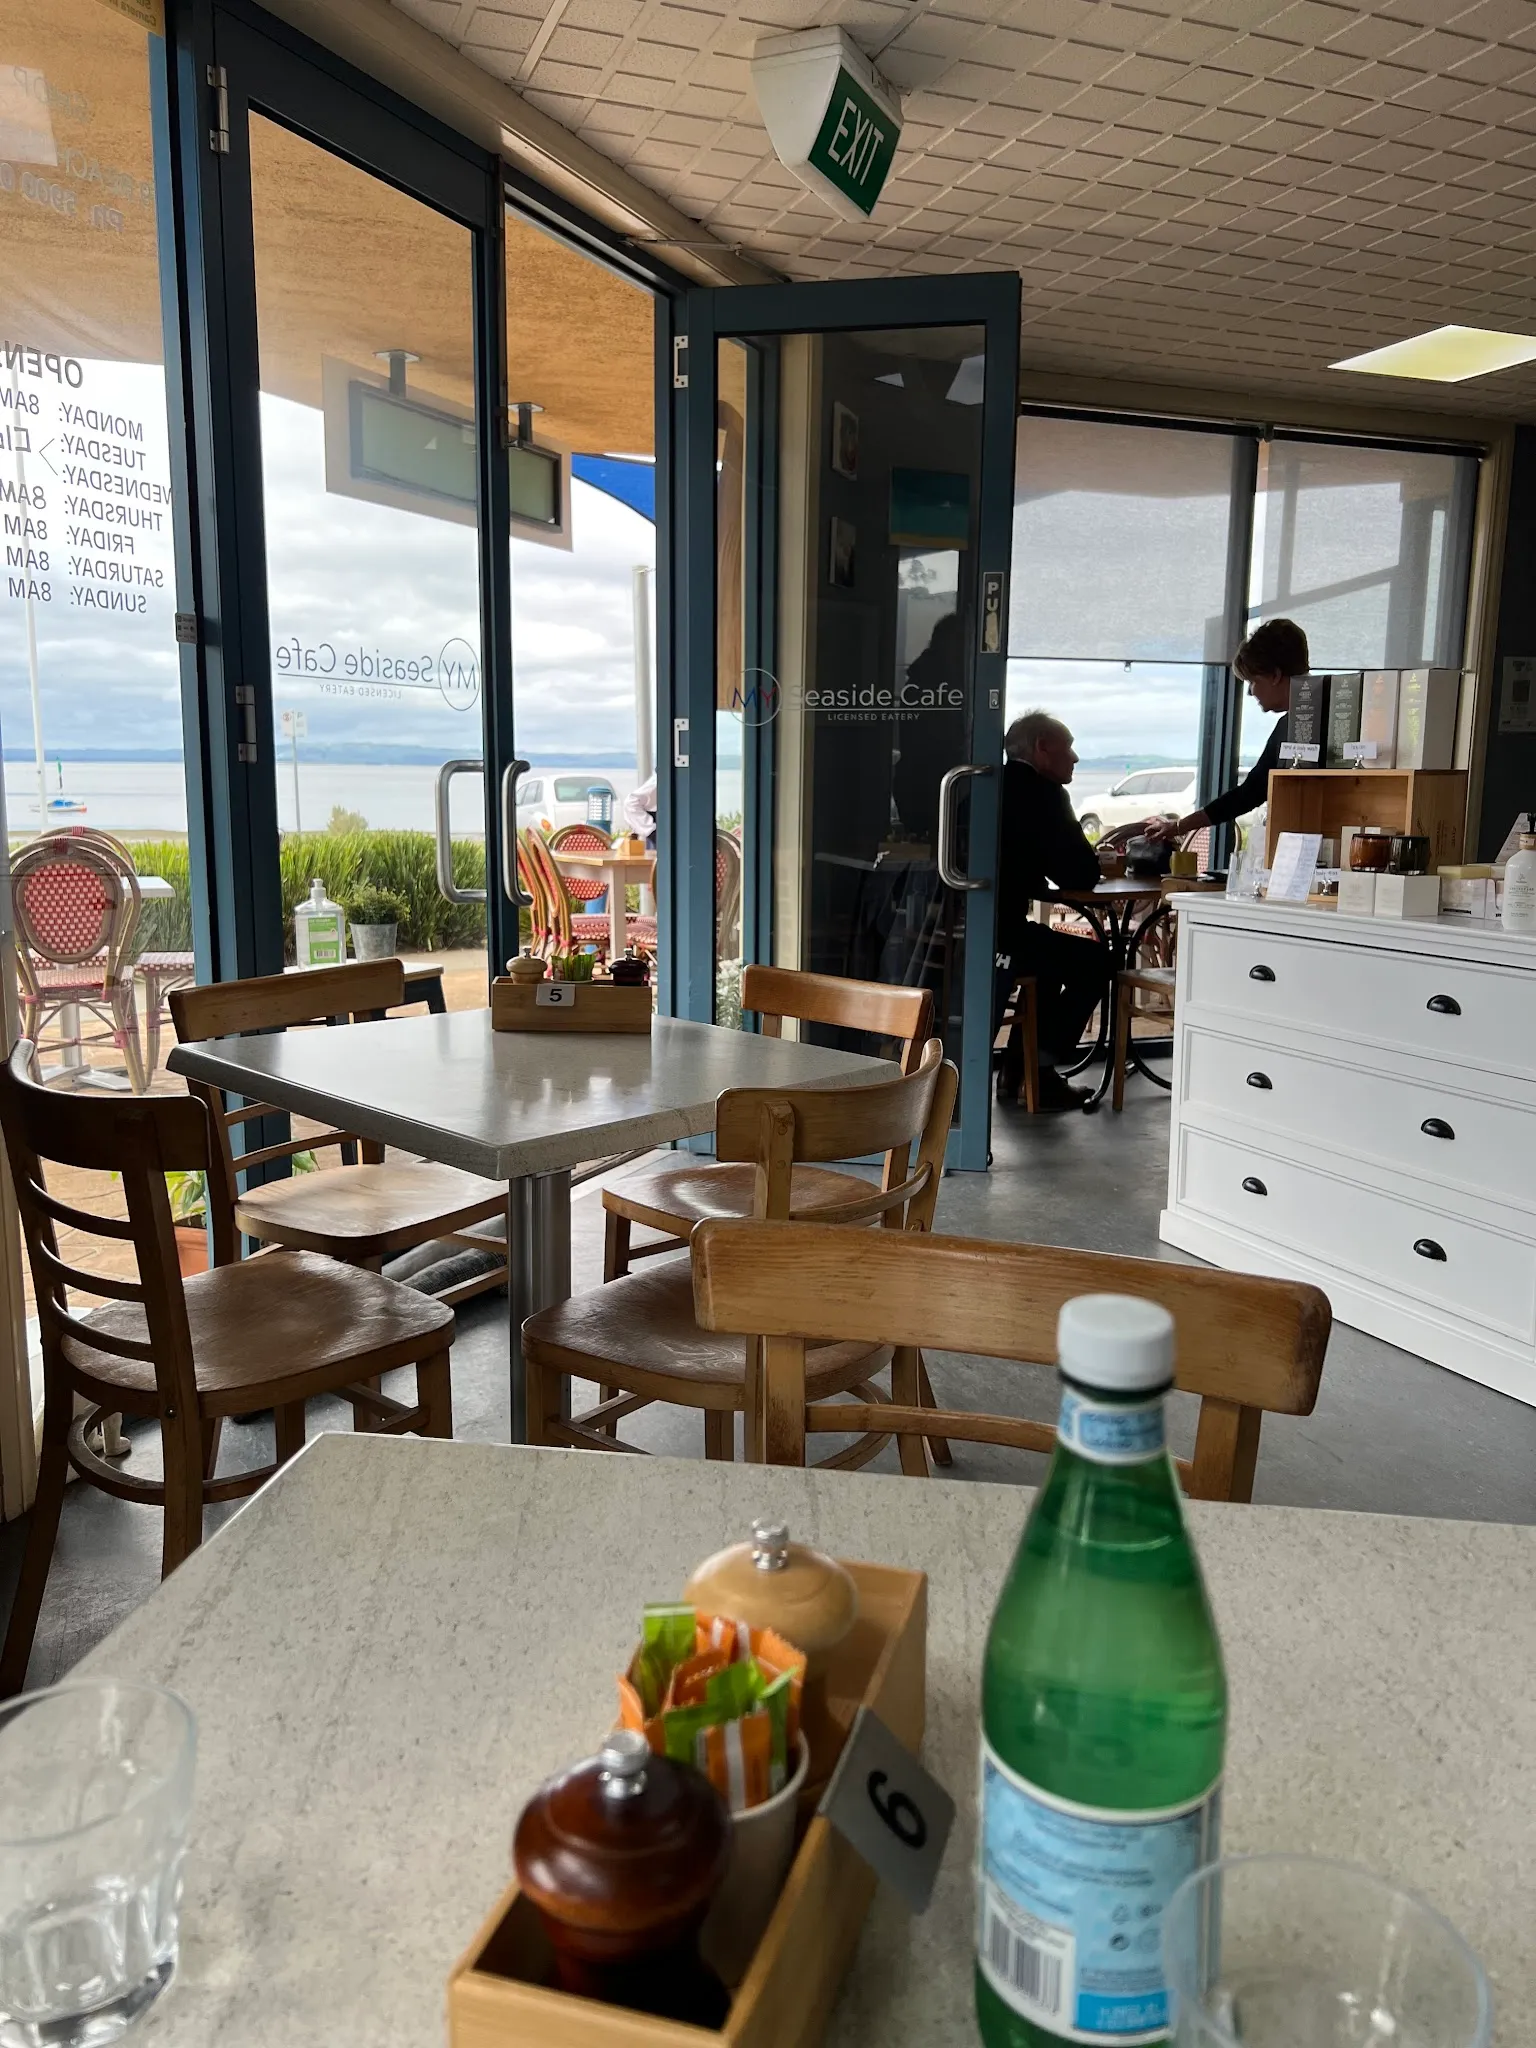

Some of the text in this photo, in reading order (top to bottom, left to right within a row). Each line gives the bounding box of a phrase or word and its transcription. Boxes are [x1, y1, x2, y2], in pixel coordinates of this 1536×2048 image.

[828, 97, 884, 186] EXIT
[732, 682, 964, 708] MY Seaside Cafe
[827, 713, 921, 722] LICENSED EATERY
[549, 988, 563, 1002] 5
[867, 1770, 927, 1848] 6
